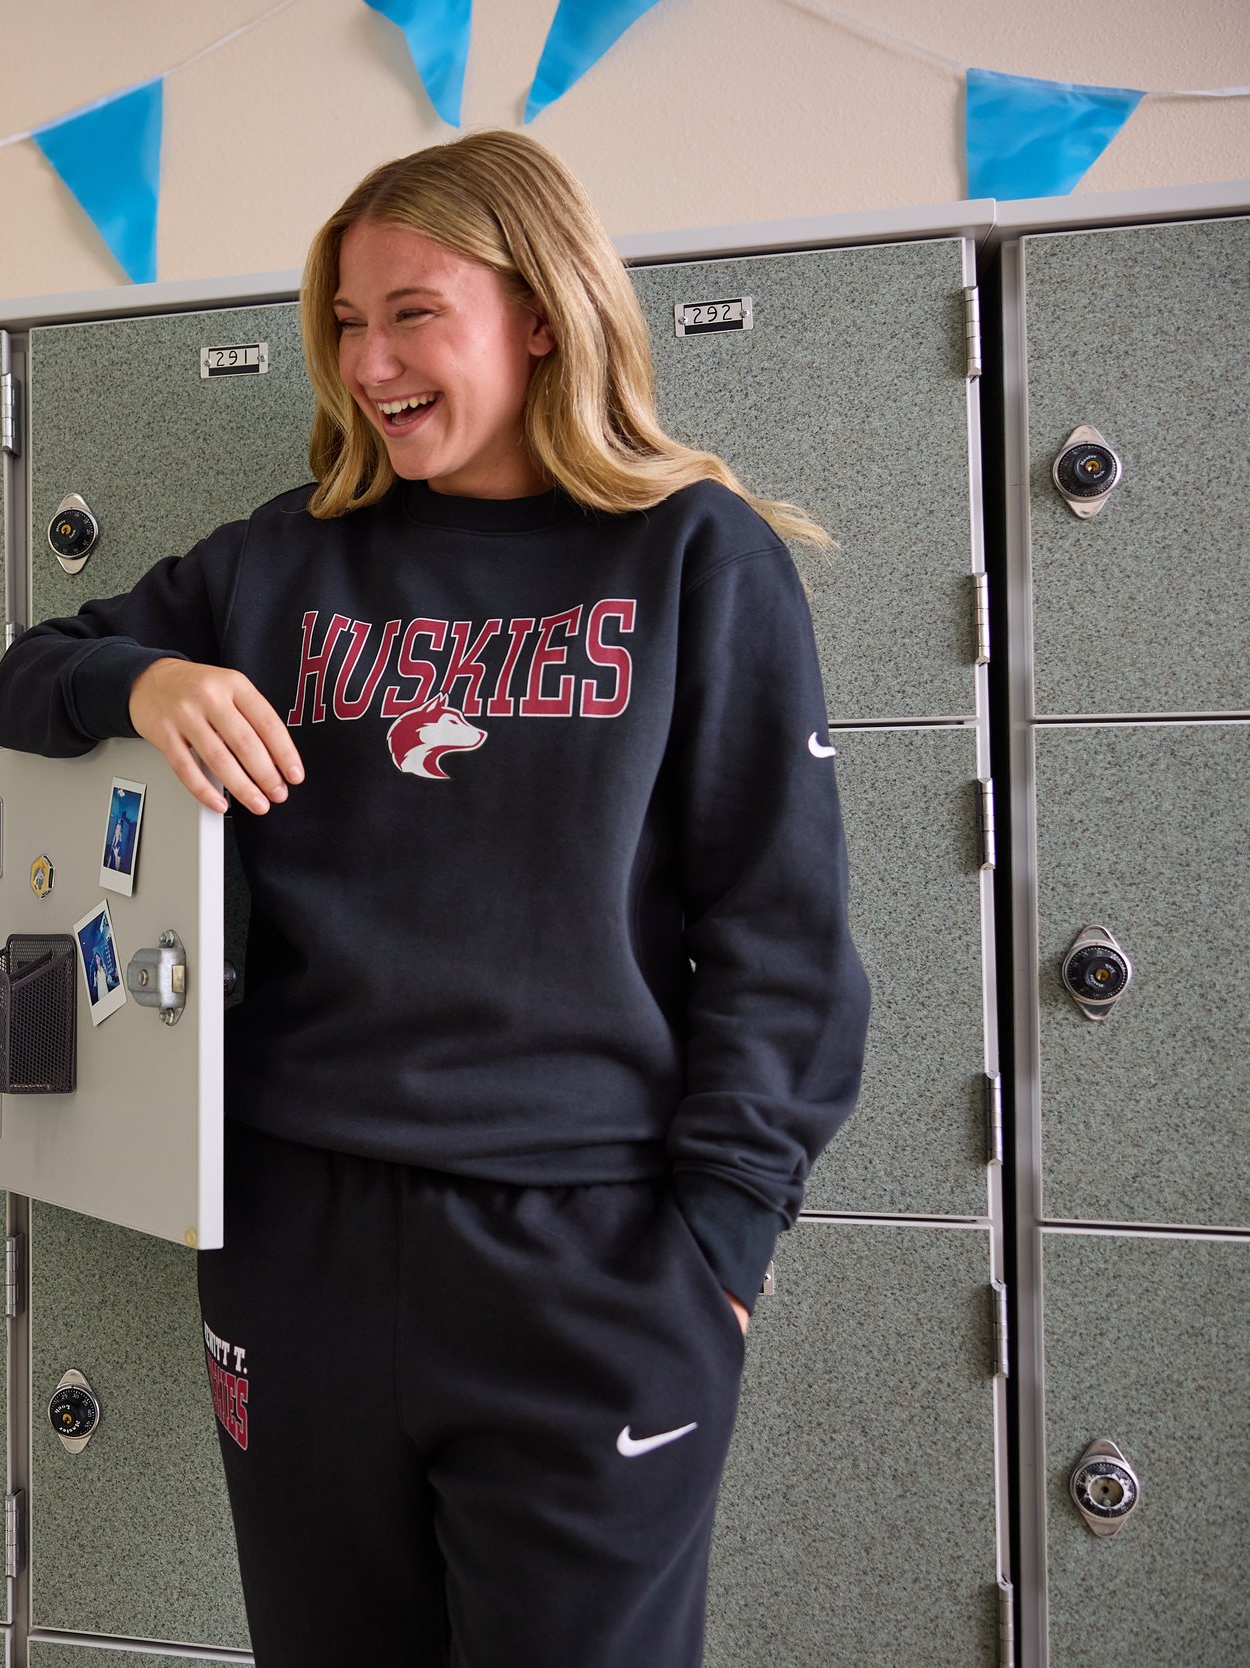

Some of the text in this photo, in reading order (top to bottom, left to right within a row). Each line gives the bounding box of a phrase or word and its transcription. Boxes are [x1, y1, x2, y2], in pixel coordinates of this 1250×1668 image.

[692, 303, 733, 324] 292
[216, 349, 248, 367] 291
[287, 599, 636, 726] HUSKIES
[234, 1345, 248, 1374] T.
